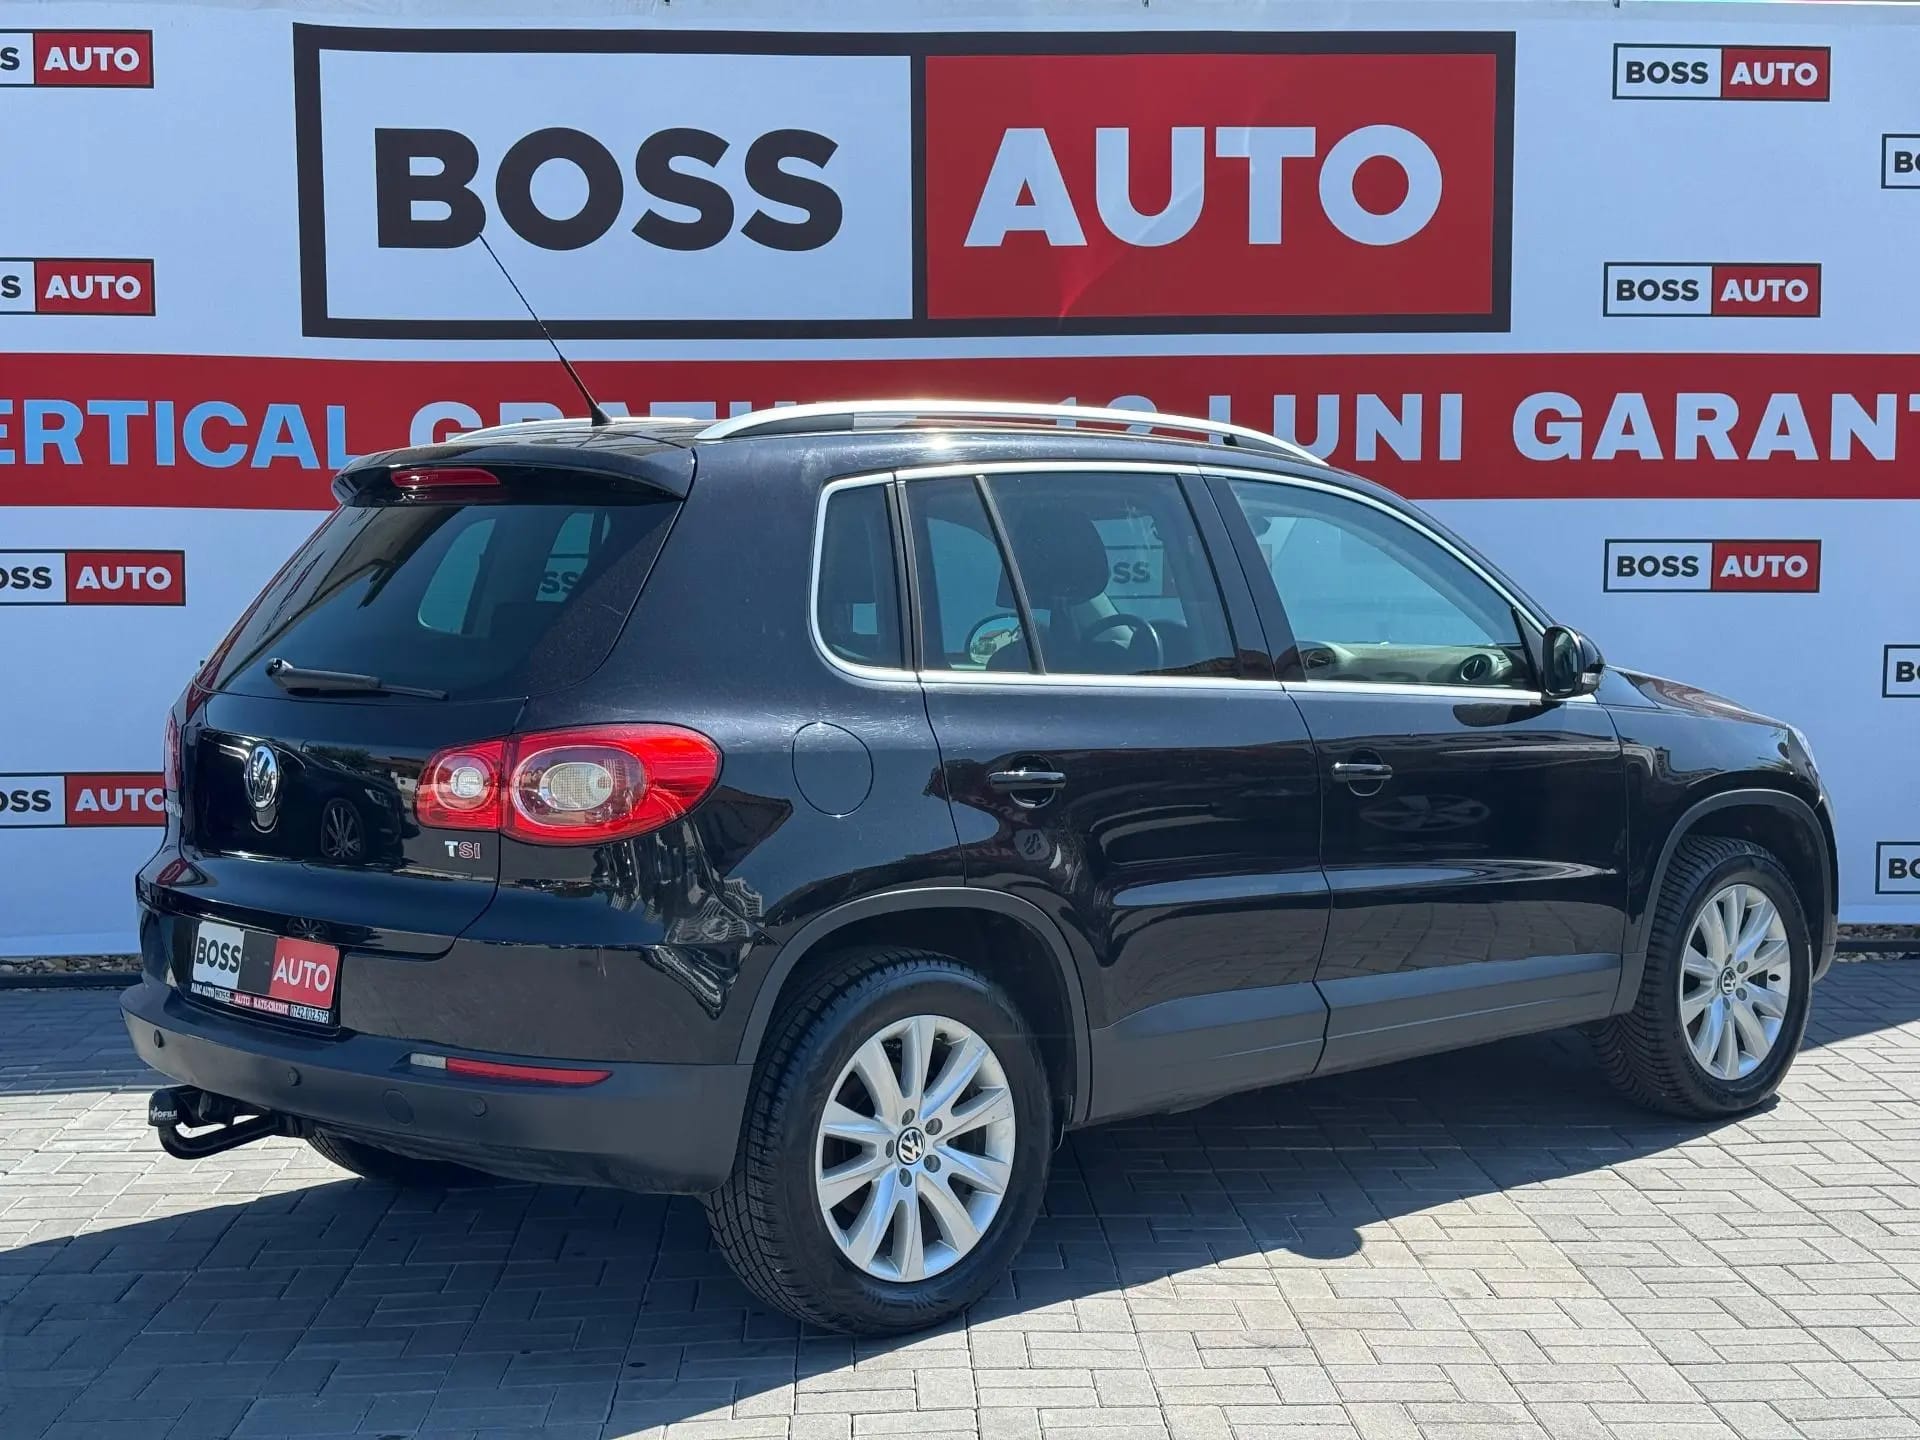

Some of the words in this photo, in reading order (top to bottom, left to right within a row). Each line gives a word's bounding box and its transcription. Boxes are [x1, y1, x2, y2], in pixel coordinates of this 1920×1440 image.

[44, 47, 139, 72] AUTO
[1626, 61, 1709, 85] BOSS
[1730, 62, 1818, 86] AUTO
[1895, 151, 1920, 173] B
[374, 126, 843, 251] BOSS
[963, 124, 1442, 247] AUTO
[45, 275, 142, 300] AUTO
[1616, 279, 1699, 302] BOSS
[1720, 279, 1808, 303] AUTO
[1512, 391, 1920, 461] GARAN
[76, 566, 172, 590] AUTO
[1617, 555, 1699, 578] BOSS
[1720, 555, 1808, 579] AUTO
[1896, 661, 1920, 683] B
[75, 788, 165, 812] AUTO
[444, 840, 481, 860] TSI
[196, 936, 242, 974] BOSS
[273, 955, 331, 992] AUTO
